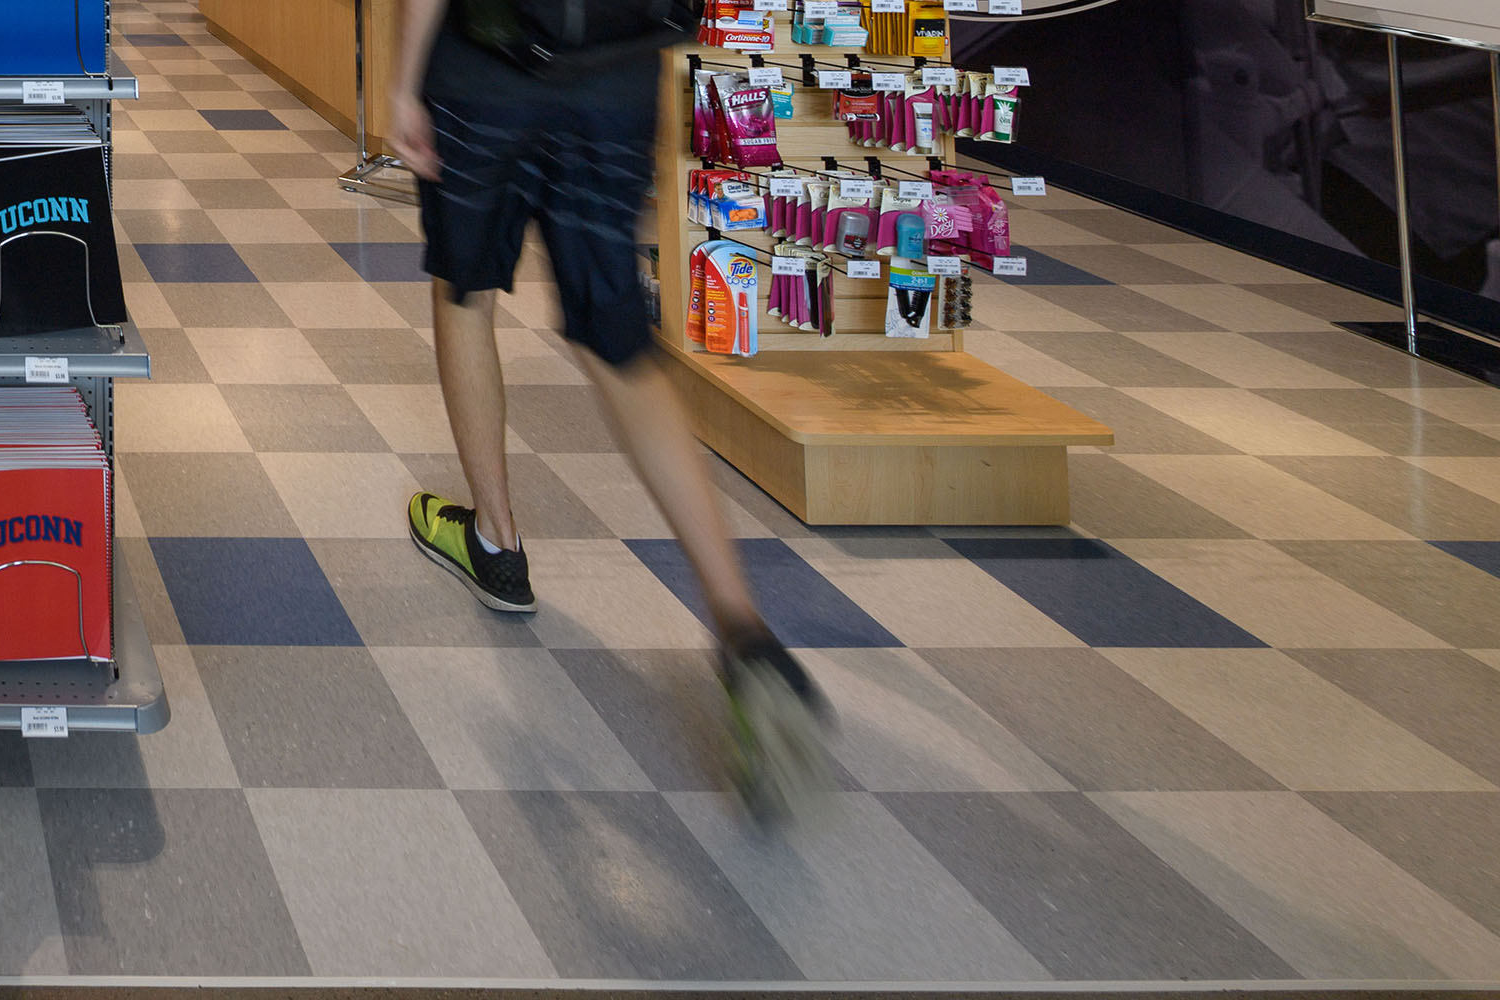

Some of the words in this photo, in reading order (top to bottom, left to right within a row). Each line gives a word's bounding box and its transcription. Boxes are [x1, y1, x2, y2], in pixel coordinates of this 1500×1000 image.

[725, 34, 770, 43] Cortizone-10
[731, 90, 766, 104] HALLS
[930, 218, 954, 237] Daisy
[731, 263, 753, 276] Tide
[726, 276, 739, 285] to
[741, 278, 757, 288] go
